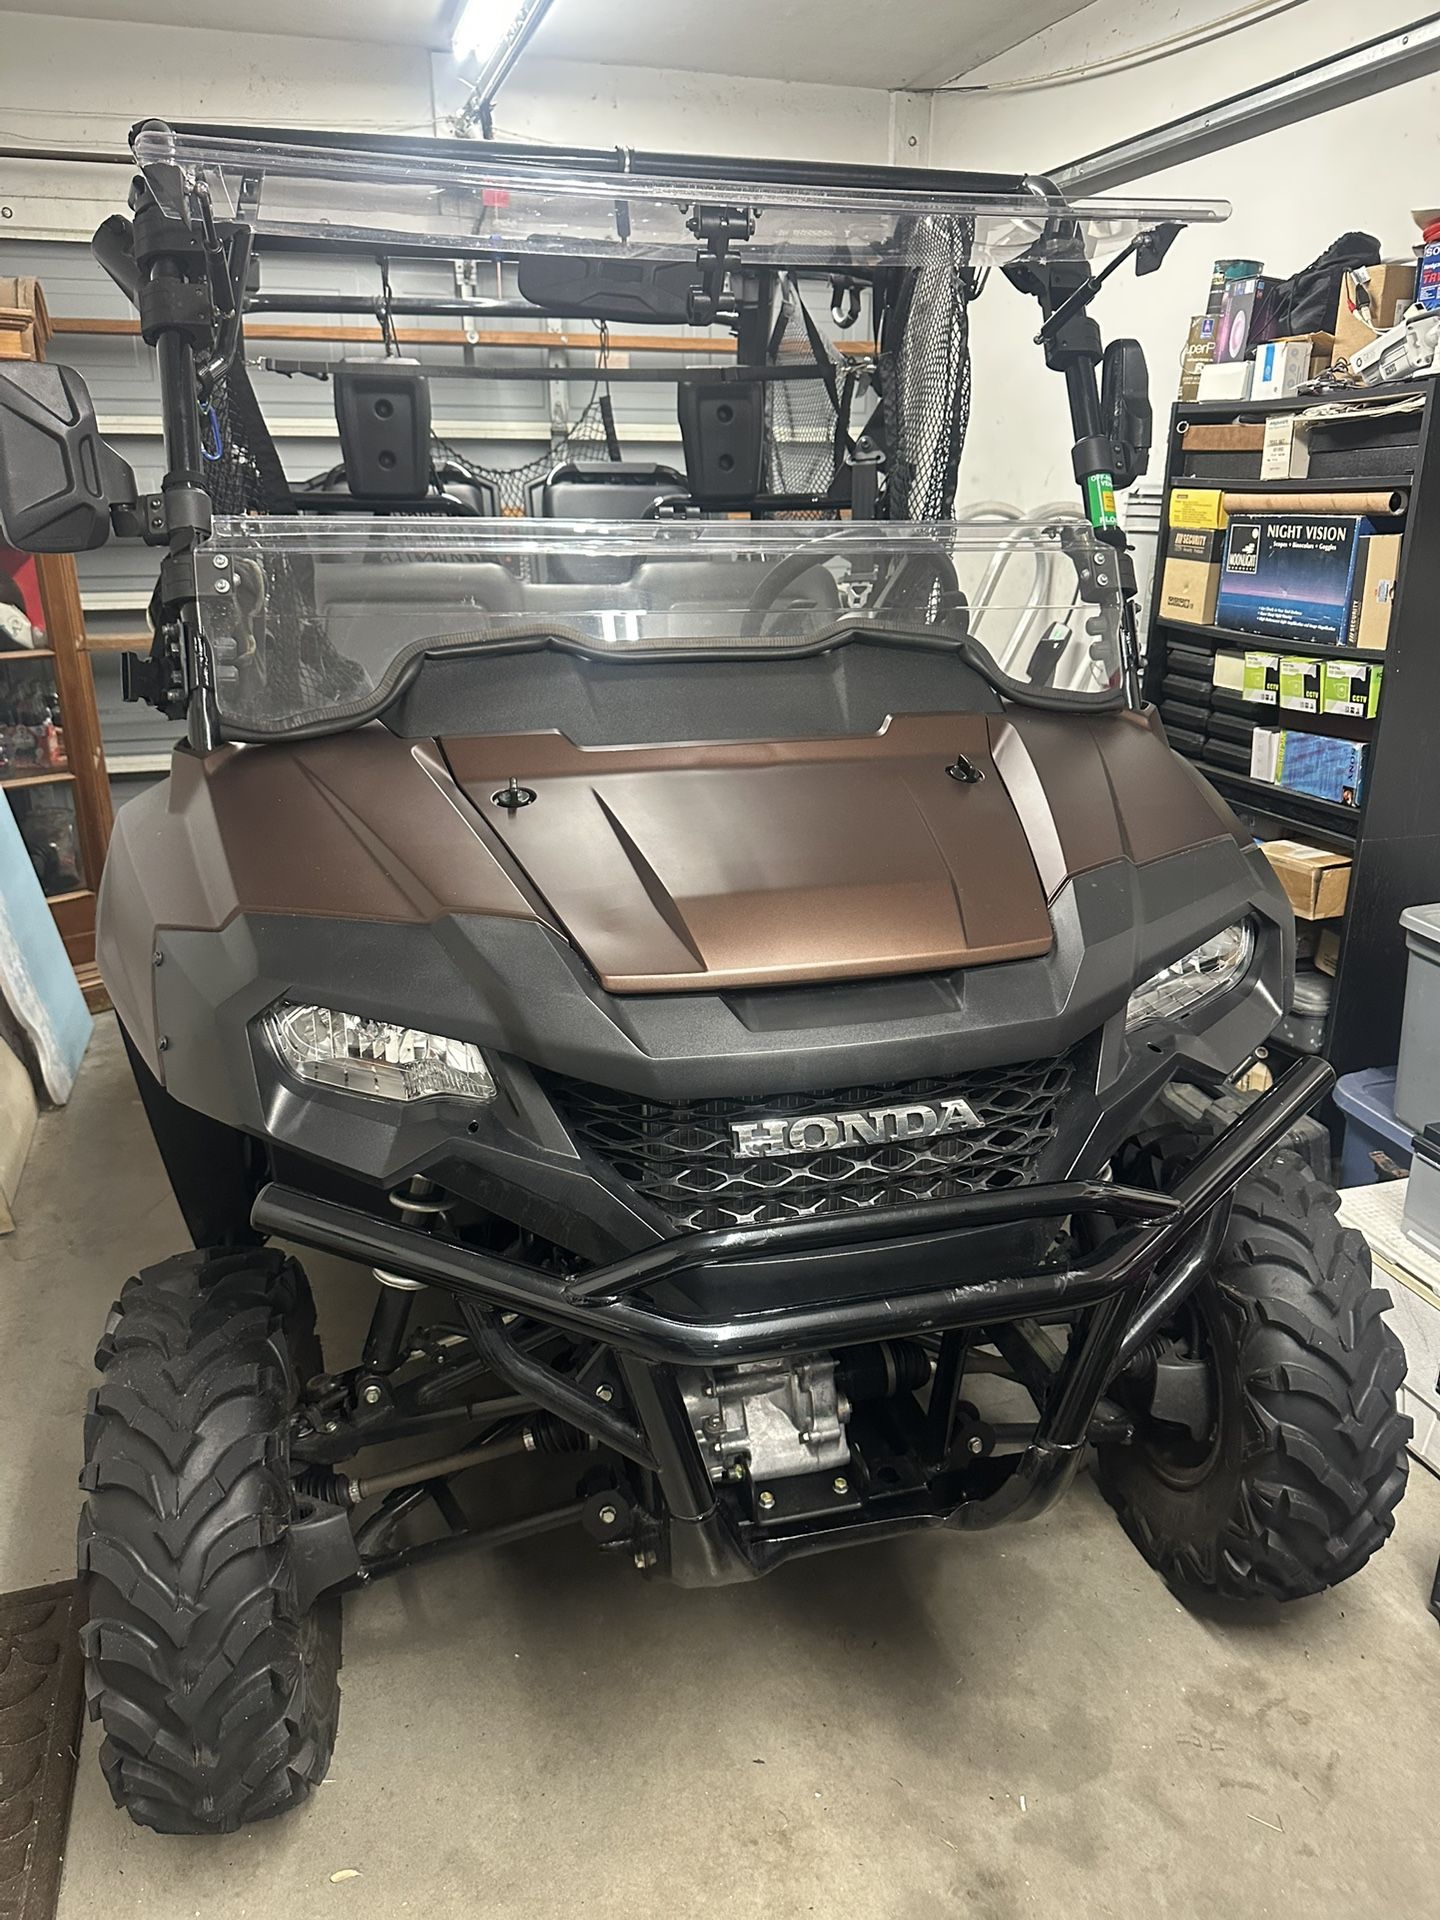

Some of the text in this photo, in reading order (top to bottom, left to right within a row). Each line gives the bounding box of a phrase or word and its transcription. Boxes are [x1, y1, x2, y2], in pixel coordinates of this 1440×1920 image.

[1267, 524, 1347, 541] NIGHT VISION
[1273, 541, 1287, 549] Scopes
[1319, 543, 1337, 552] Goggles
[1350, 600, 1359, 632] SECURITY
[1266, 683, 1279, 691] CCTV
[1305, 690, 1319, 699] CCTV
[1352, 694, 1368, 704] CCTV
[1347, 747, 1356, 782] SONY
[731, 1098, 985, 1158] HONDA
